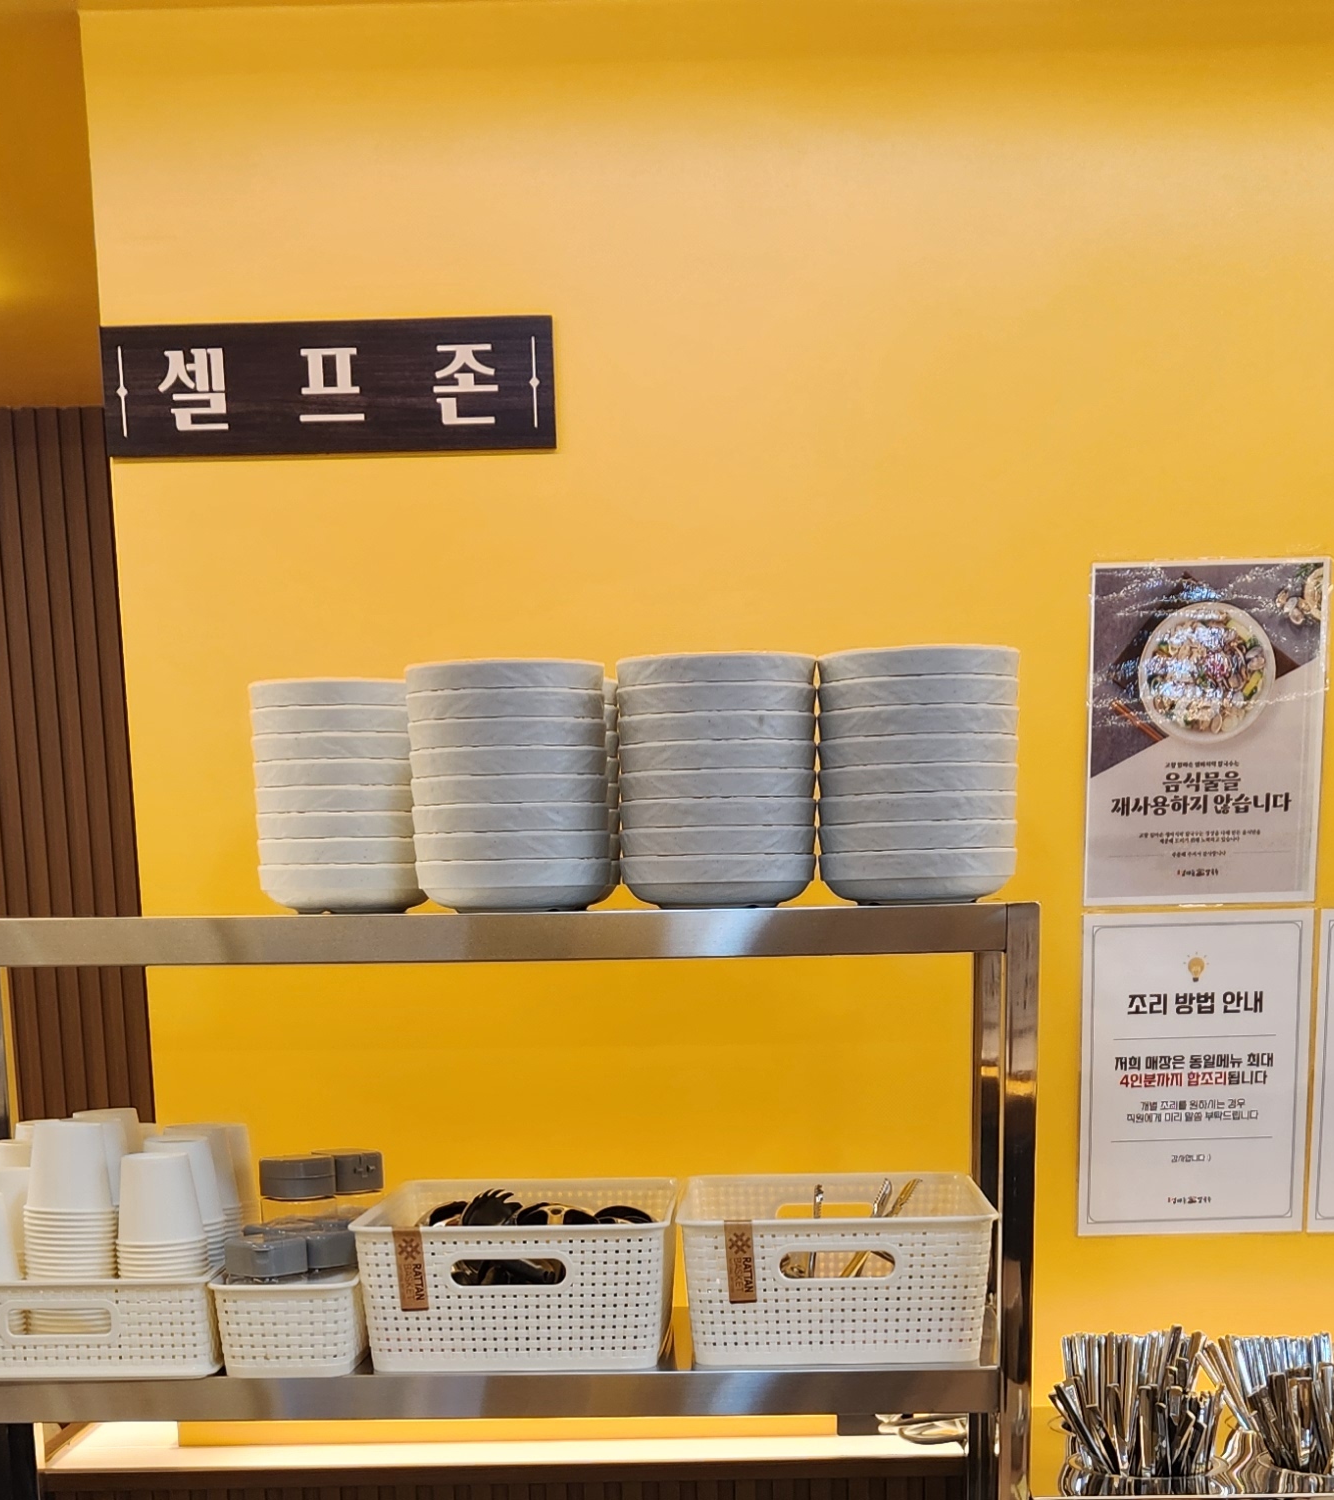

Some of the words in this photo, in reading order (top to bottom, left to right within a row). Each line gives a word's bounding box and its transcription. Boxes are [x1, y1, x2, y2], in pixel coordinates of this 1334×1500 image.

[1163, 771, 1241, 793] 음식물을
[1111, 794, 1208, 816] 재사용하지
[1214, 792, 1292, 814] 않습니다
[1127, 993, 1167, 1015] 조리
[1175, 992, 1215, 1014] 방법
[1223, 991, 1263, 1014] 안내
[1115, 1056, 1141, 1071] 저희
[1145, 1055, 1185, 1070] 매장은
[1189, 1054, 1243, 1069] 동일메뉴
[1247, 1052, 1274, 1067] 최대
[1119, 1072, 1183, 1088] 4인분까지
[1188, 1070, 1268, 1087] 합조리됩니다
[1227, 1098, 1245, 1109] 경우
[1126, 1112, 1162, 1123] 직원에게
[1164, 1112, 1183, 1122] 미리
[1205, 1110, 1259, 1121] 부탁드립니다
[412, 1263, 425, 1301] RATTAN
[742, 1256, 754, 1293] RATTAN
